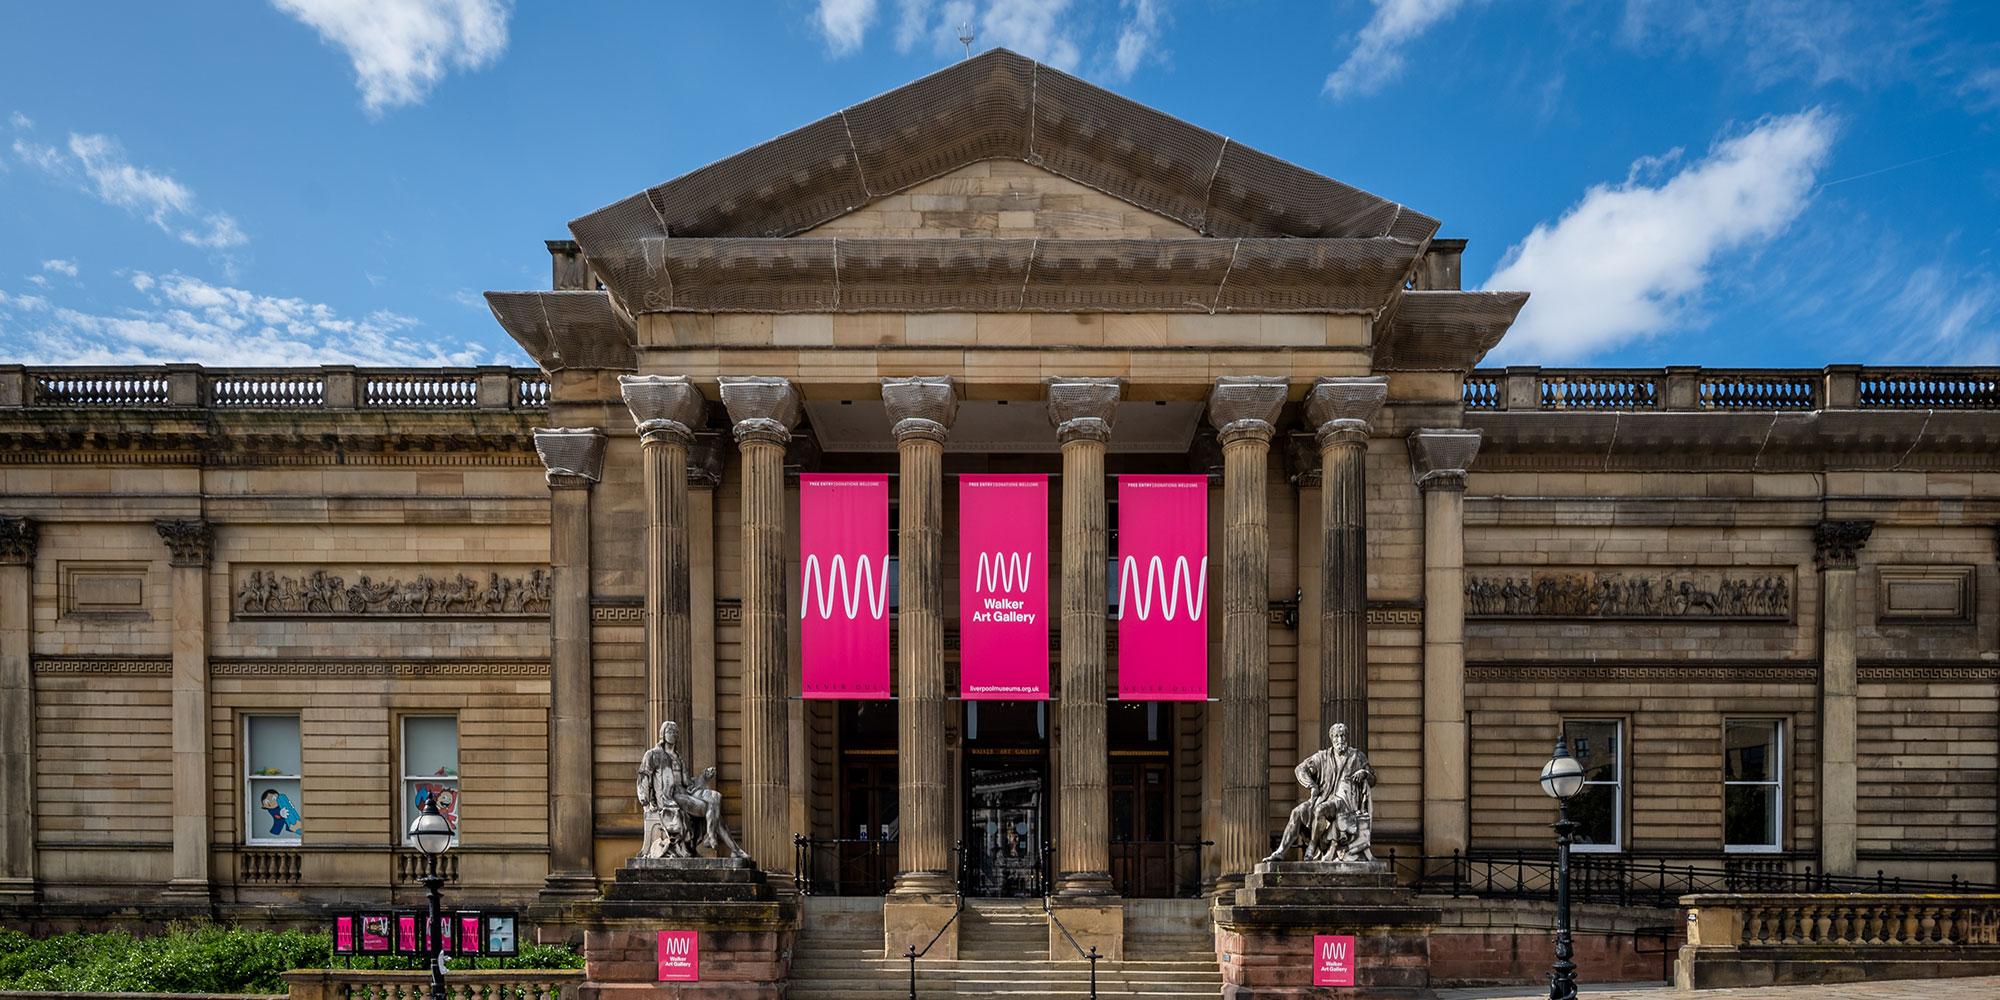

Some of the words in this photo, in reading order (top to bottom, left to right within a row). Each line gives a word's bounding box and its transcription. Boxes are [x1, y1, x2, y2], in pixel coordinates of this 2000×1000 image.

[984, 598, 1024, 609] Walker
[972, 611, 991, 622] Art
[993, 611, 1035, 624] Gallery
